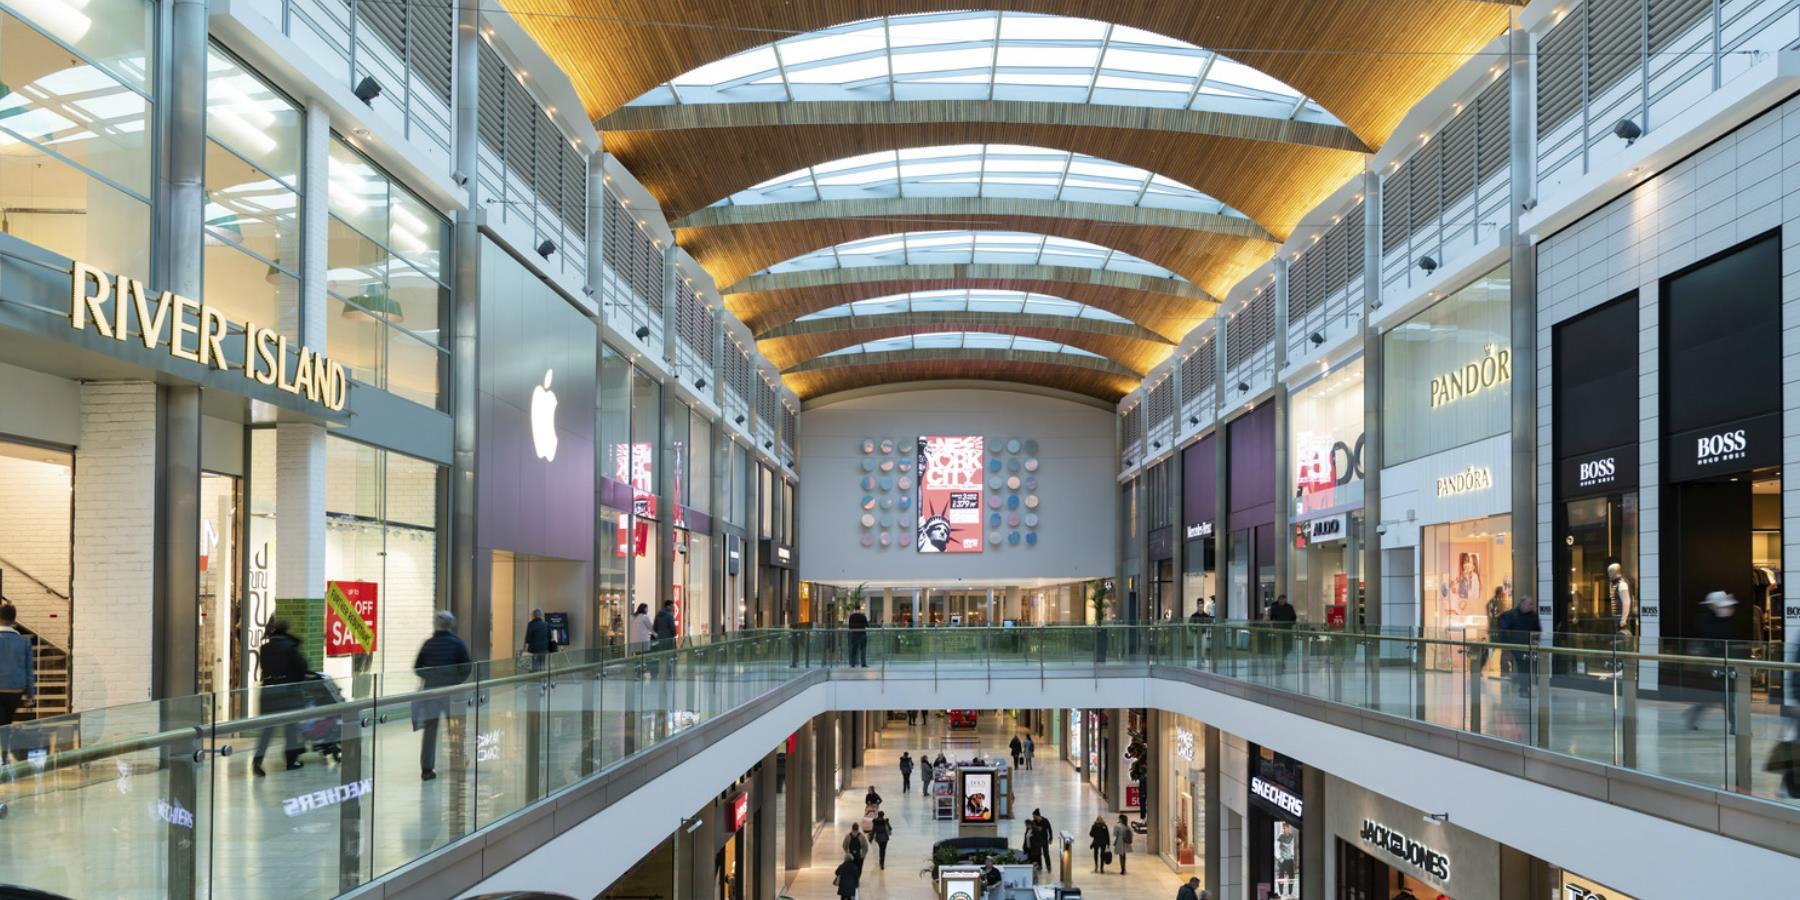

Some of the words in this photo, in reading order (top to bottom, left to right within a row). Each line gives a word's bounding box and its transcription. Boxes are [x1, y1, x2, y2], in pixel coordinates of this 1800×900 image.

[71, 260, 228, 371] RIVER
[244, 321, 346, 412] ISLAND
[1431, 350, 1510, 407] PANDOR
[1697, 429, 1746, 458] BOSS
[928, 450, 983, 470] YORK
[1580, 457, 1615, 480] BOSS
[926, 468, 978, 486] CITY
[1436, 469, 1490, 497] PANDORA
[1313, 519, 1340, 537] ALDO
[354, 600, 374, 615] OFF
[1251, 776, 1303, 817] SKECHERS
